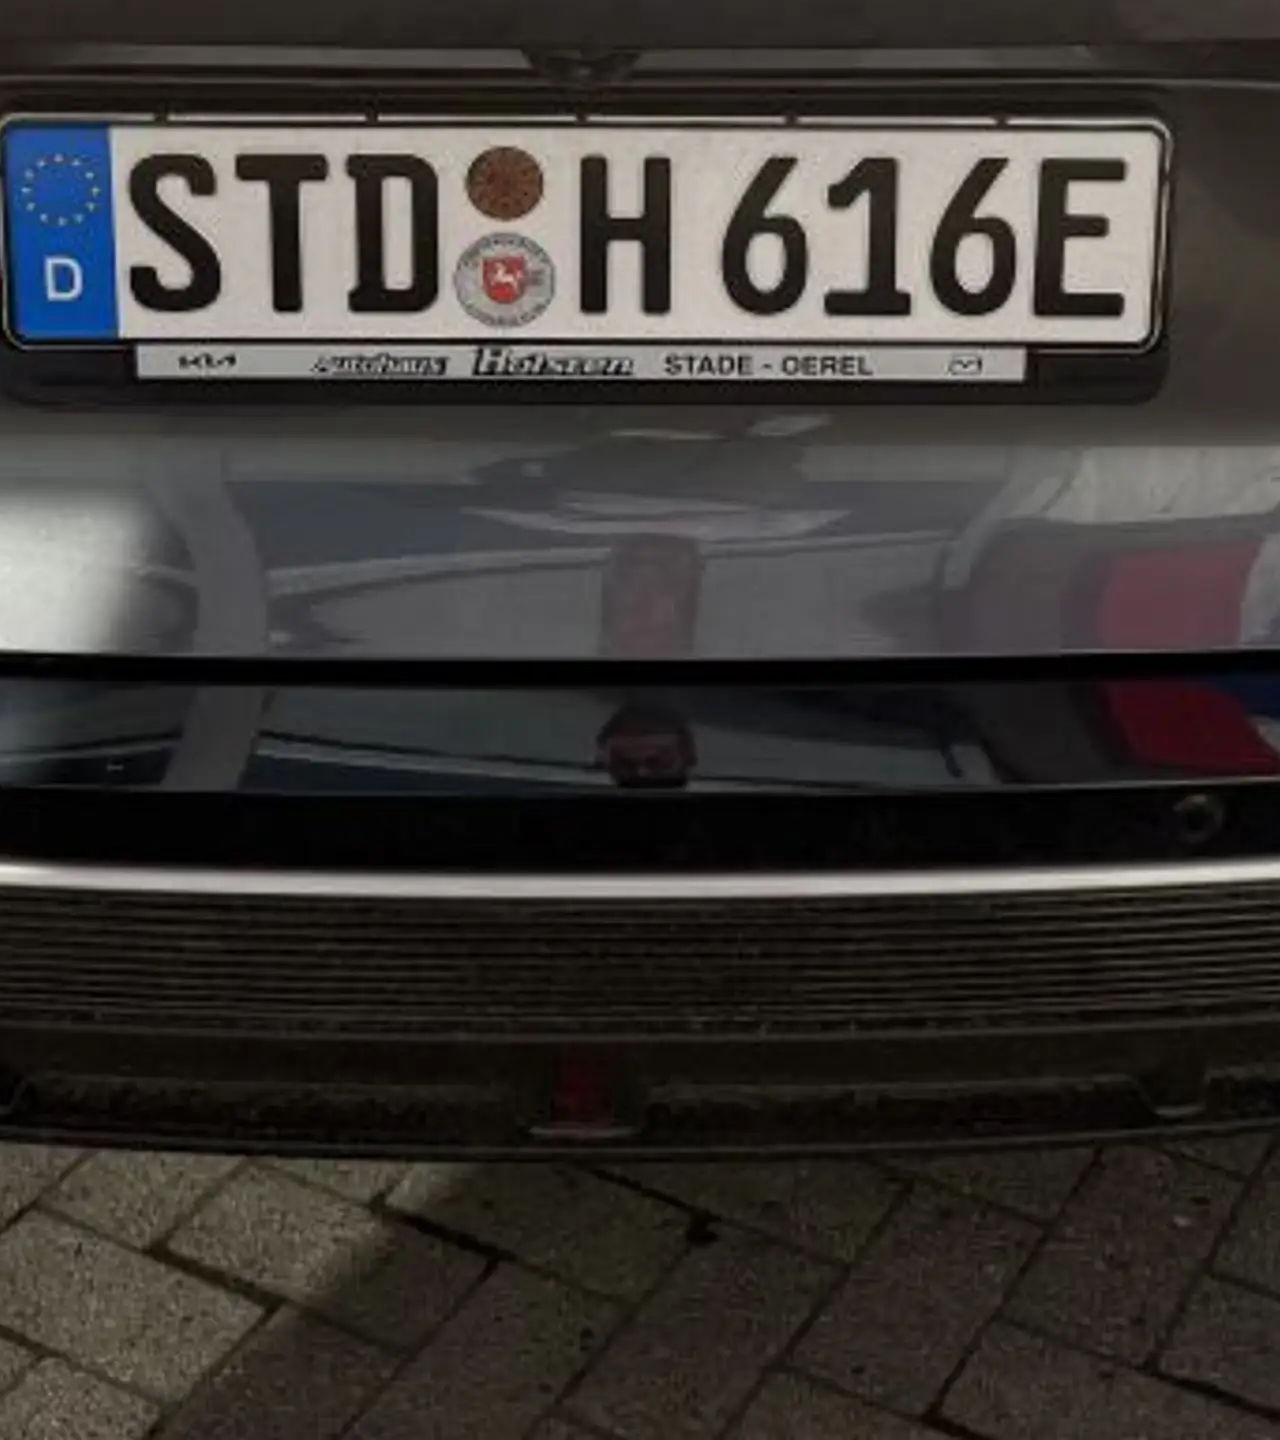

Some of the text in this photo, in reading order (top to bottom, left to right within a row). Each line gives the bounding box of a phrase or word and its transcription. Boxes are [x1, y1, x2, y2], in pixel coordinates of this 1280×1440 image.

[127, 154, 440, 313] STD
[579, 156, 671, 314] H
[721, 157, 1128, 317] 616E
[44, 258, 84, 303] D
[663, 354, 756, 376] STADE
[780, 355, 875, 376] OEREL
